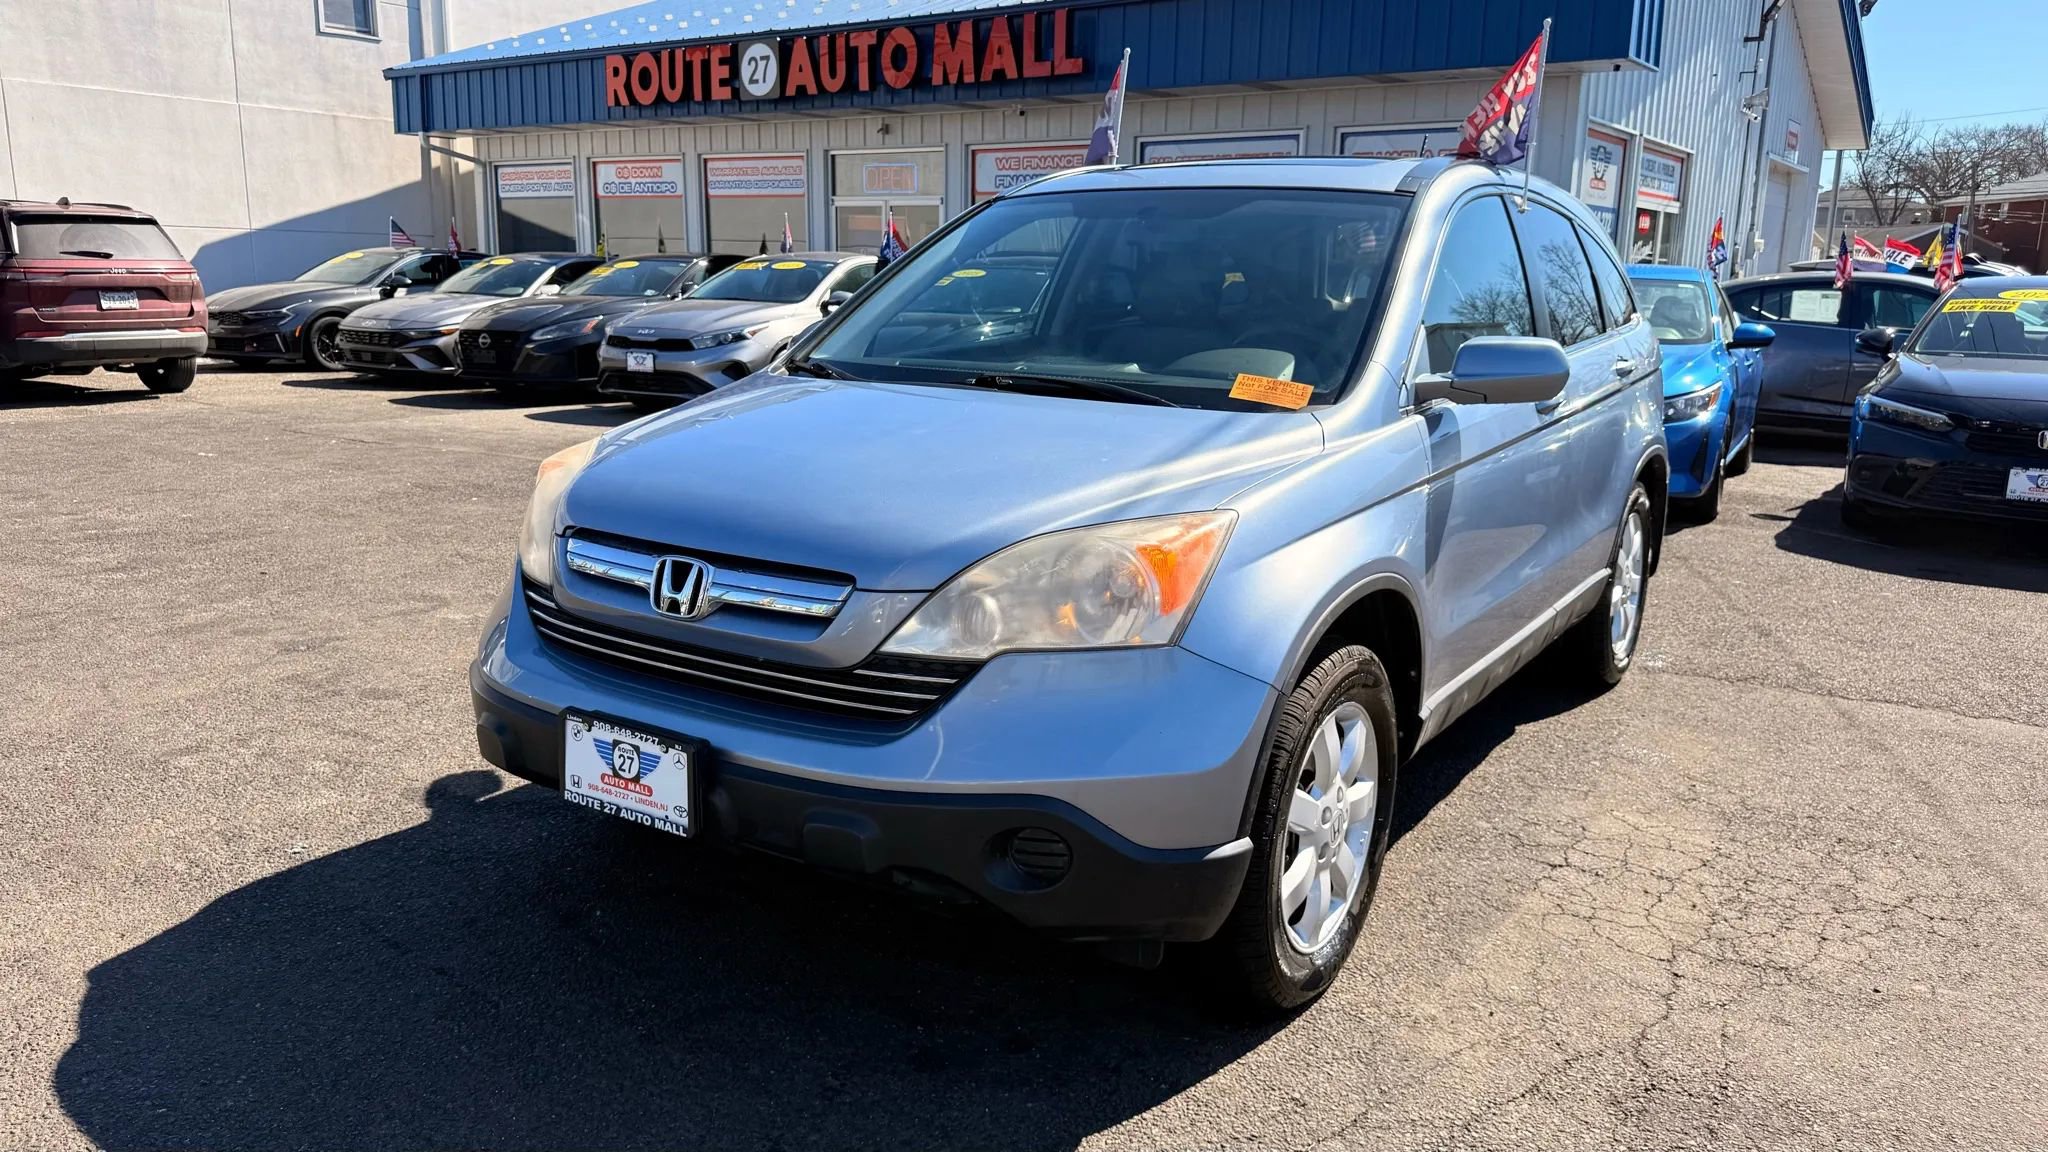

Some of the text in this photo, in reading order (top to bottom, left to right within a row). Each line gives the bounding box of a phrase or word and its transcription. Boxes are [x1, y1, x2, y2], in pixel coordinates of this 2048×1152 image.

[606, 8, 1084, 107] ROUTE 27 AUTO MALL
[996, 154, 1085, 170] WE FINANCE
[535, 170, 555, 180] YOUR
[556, 169, 572, 179] CAR
[616, 166, 662, 179] 0$ DOWN
[761, 165, 802, 176] AVAILABLE
[501, 182, 575, 193] DINERO POR TU AUTO
[603, 181, 677, 195] 0$ DE ANTICIPO
[1241, 375, 1308, 391] THIS VEHICLE
[1257, 383, 1279, 392] FOR
[1280, 388, 1307, 398] SALE
[593, 720, 660, 747] 908-648-2727
[617, 746, 635, 756] ROUTE
[618, 754, 635, 774] 27
[587, 782, 630, 800] 908-648-2727
[604, 774, 650, 796] AUTO MALL
[564, 790, 687, 838] ROUTE 27 AUTO MALL
